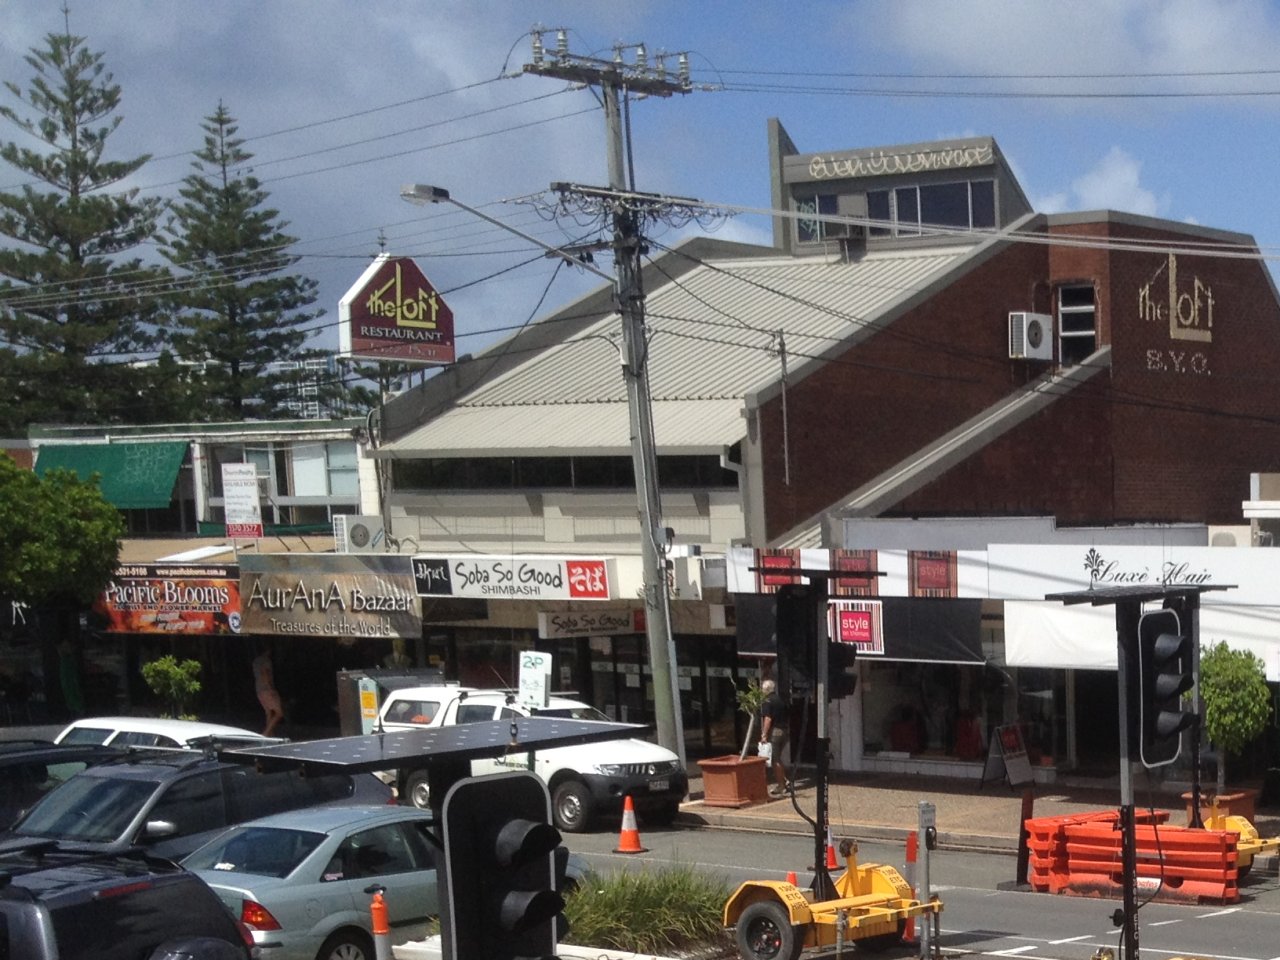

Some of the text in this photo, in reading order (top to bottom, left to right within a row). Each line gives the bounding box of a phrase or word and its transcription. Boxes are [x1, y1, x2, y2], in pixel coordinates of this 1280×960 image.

[360, 326, 443, 341] RESTAURANT
[455, 562, 489, 589] Soba
[492, 562, 514, 584] So
[518, 563, 563, 588] Good
[570, 566, 604, 592] そば
[919, 564, 946, 578] style
[1156, 561, 1213, 584] Hair
[481, 585, 541, 595] SHIMBASHI
[192, 604, 222, 613] MARKET
[352, 588, 414, 612] Bazaar
[271, 616, 391, 635] Treasures of the World
[842, 617, 869, 631] style
